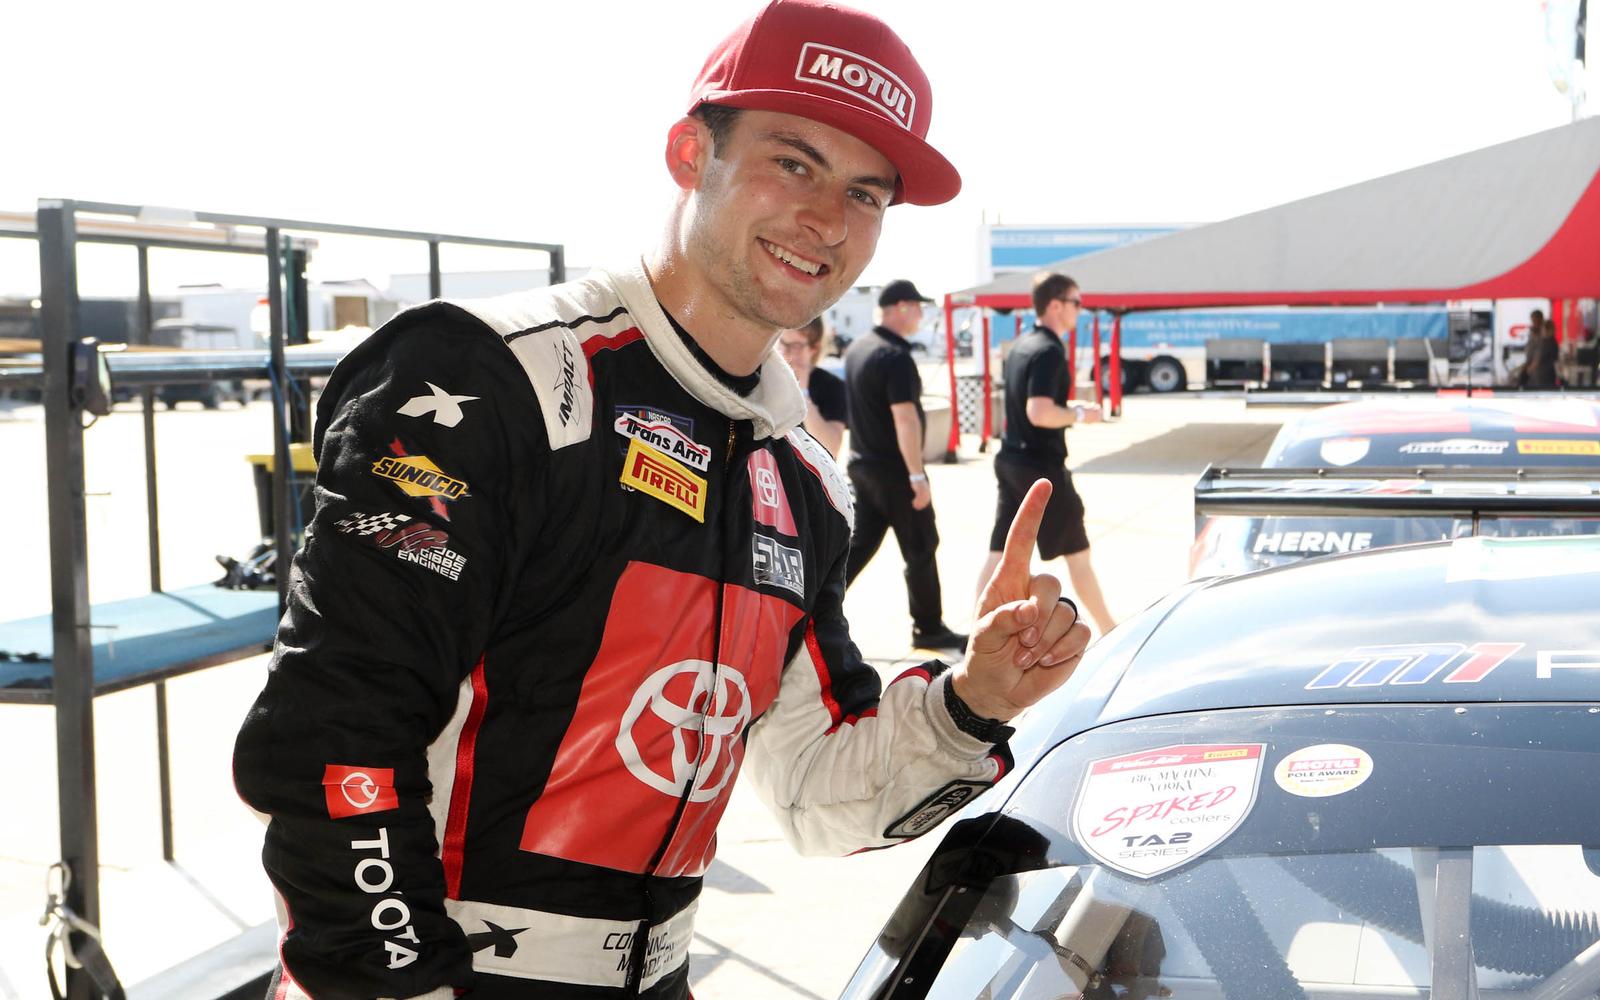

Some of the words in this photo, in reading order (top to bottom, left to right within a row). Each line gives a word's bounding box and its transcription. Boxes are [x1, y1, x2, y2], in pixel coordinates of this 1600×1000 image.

[808, 53, 907, 118] MOTUL
[558, 340, 575, 428] IMPACT
[626, 418, 671, 450] Trans
[672, 440, 704, 465] Am
[377, 458, 464, 498] SUNOCO
[632, 451, 699, 509] PIRELLI
[431, 545, 467, 563] JOE
[1253, 531, 1373, 552] HERNE
[397, 549, 460, 581] ENGINES
[420, 548, 465, 573] GIBBS
[1290, 759, 1359, 771] MOTUL
[1318, 769, 1358, 777] AWARD
[1091, 785, 1237, 838] SPIKED
[1170, 813, 1231, 825] coolers
[1118, 847, 1189, 859] SERIES
[1122, 832, 1193, 848] TA2
[351, 827, 421, 970] TOOTA
